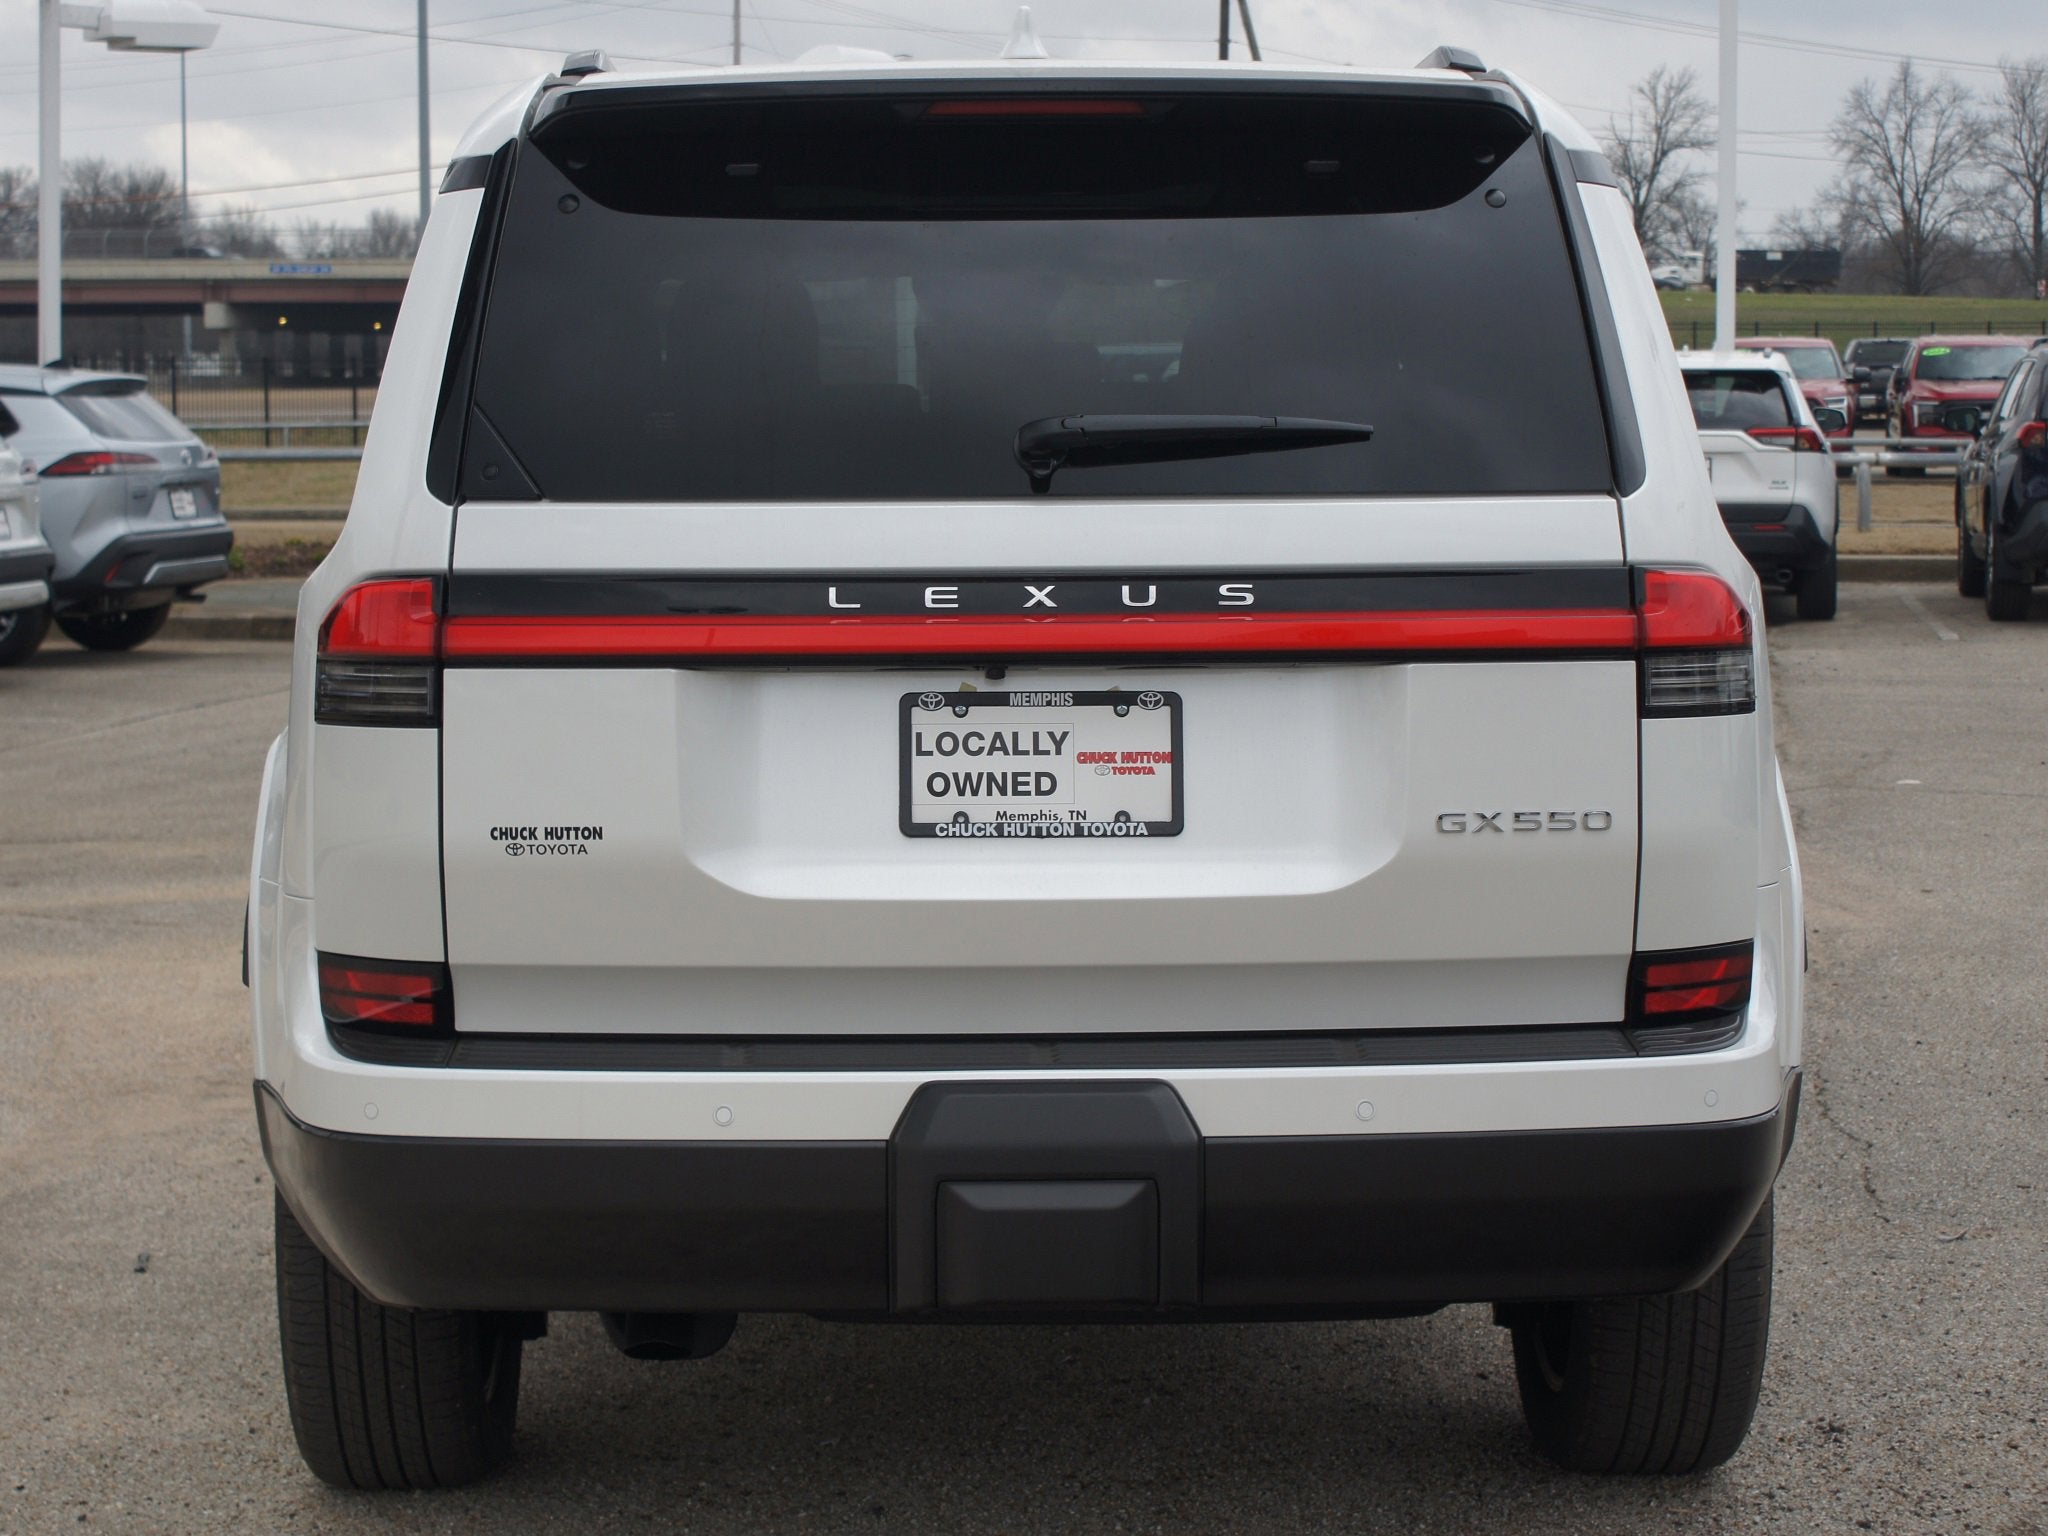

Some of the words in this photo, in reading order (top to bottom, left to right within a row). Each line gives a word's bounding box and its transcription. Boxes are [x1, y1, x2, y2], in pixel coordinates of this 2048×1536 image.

[828, 584, 1255, 609] LEXUS
[1009, 692, 1074, 707] MEMPHIS
[915, 731, 1070, 757] LOCALLY
[1076, 751, 1117, 764] CHUCK
[1121, 751, 1173, 764] HUTTON
[1111, 766, 1156, 775] TOYOTA
[926, 771, 1058, 797] OWNED
[995, 809, 1063, 824] Memphis,
[1068, 810, 1087, 821] TN
[490, 827, 538, 840] CHUCK
[544, 826, 603, 840] HUTTON
[935, 823, 998, 837] CHUCK
[1003, 823, 1075, 836] HUTTON
[1080, 822, 1149, 836] TOYOTA
[526, 844, 588, 855] TOYOTA
